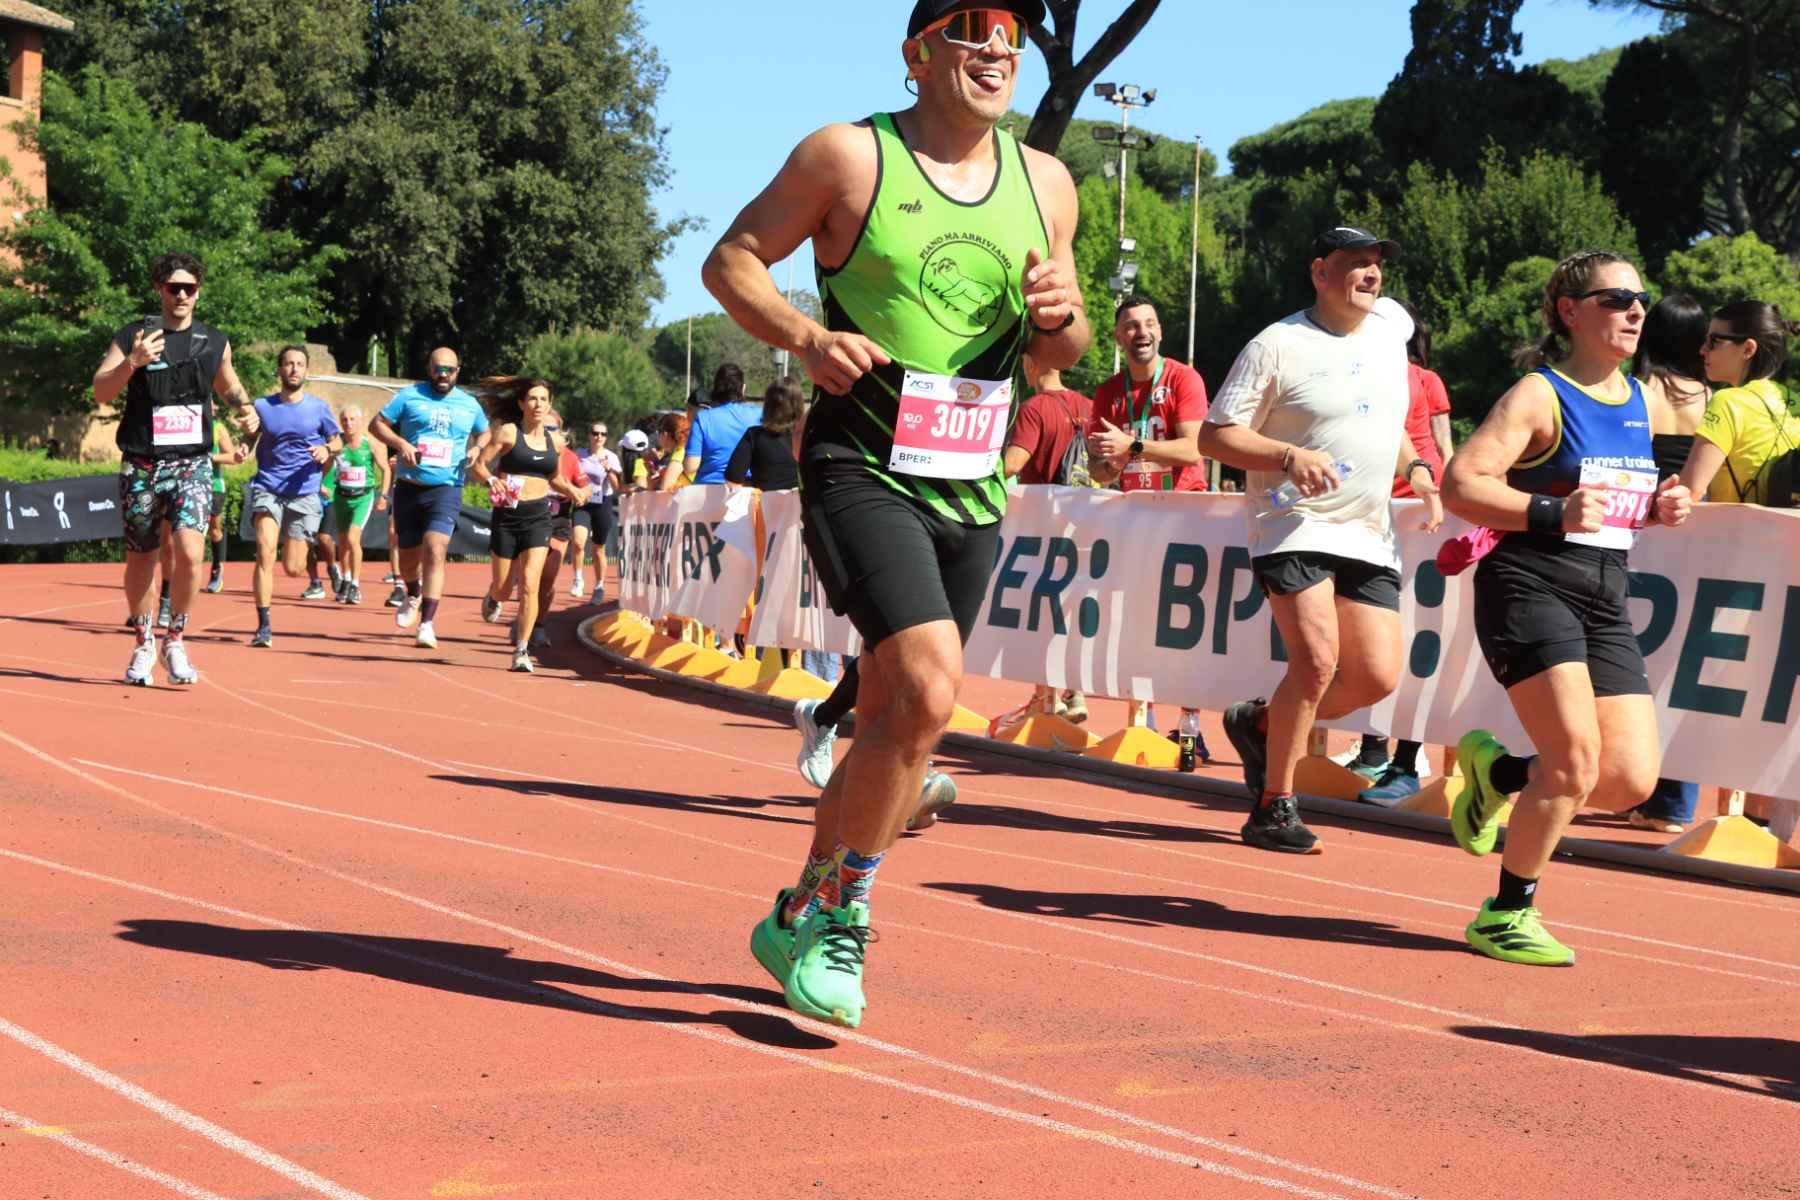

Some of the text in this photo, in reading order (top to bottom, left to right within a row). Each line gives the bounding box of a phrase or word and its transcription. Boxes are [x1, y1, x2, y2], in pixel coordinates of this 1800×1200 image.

[920, 232, 1012, 270] PIANO MA ARRIVIAMO
[931, 404, 992, 441] 3019
[1139, 474, 1152, 489] 95
